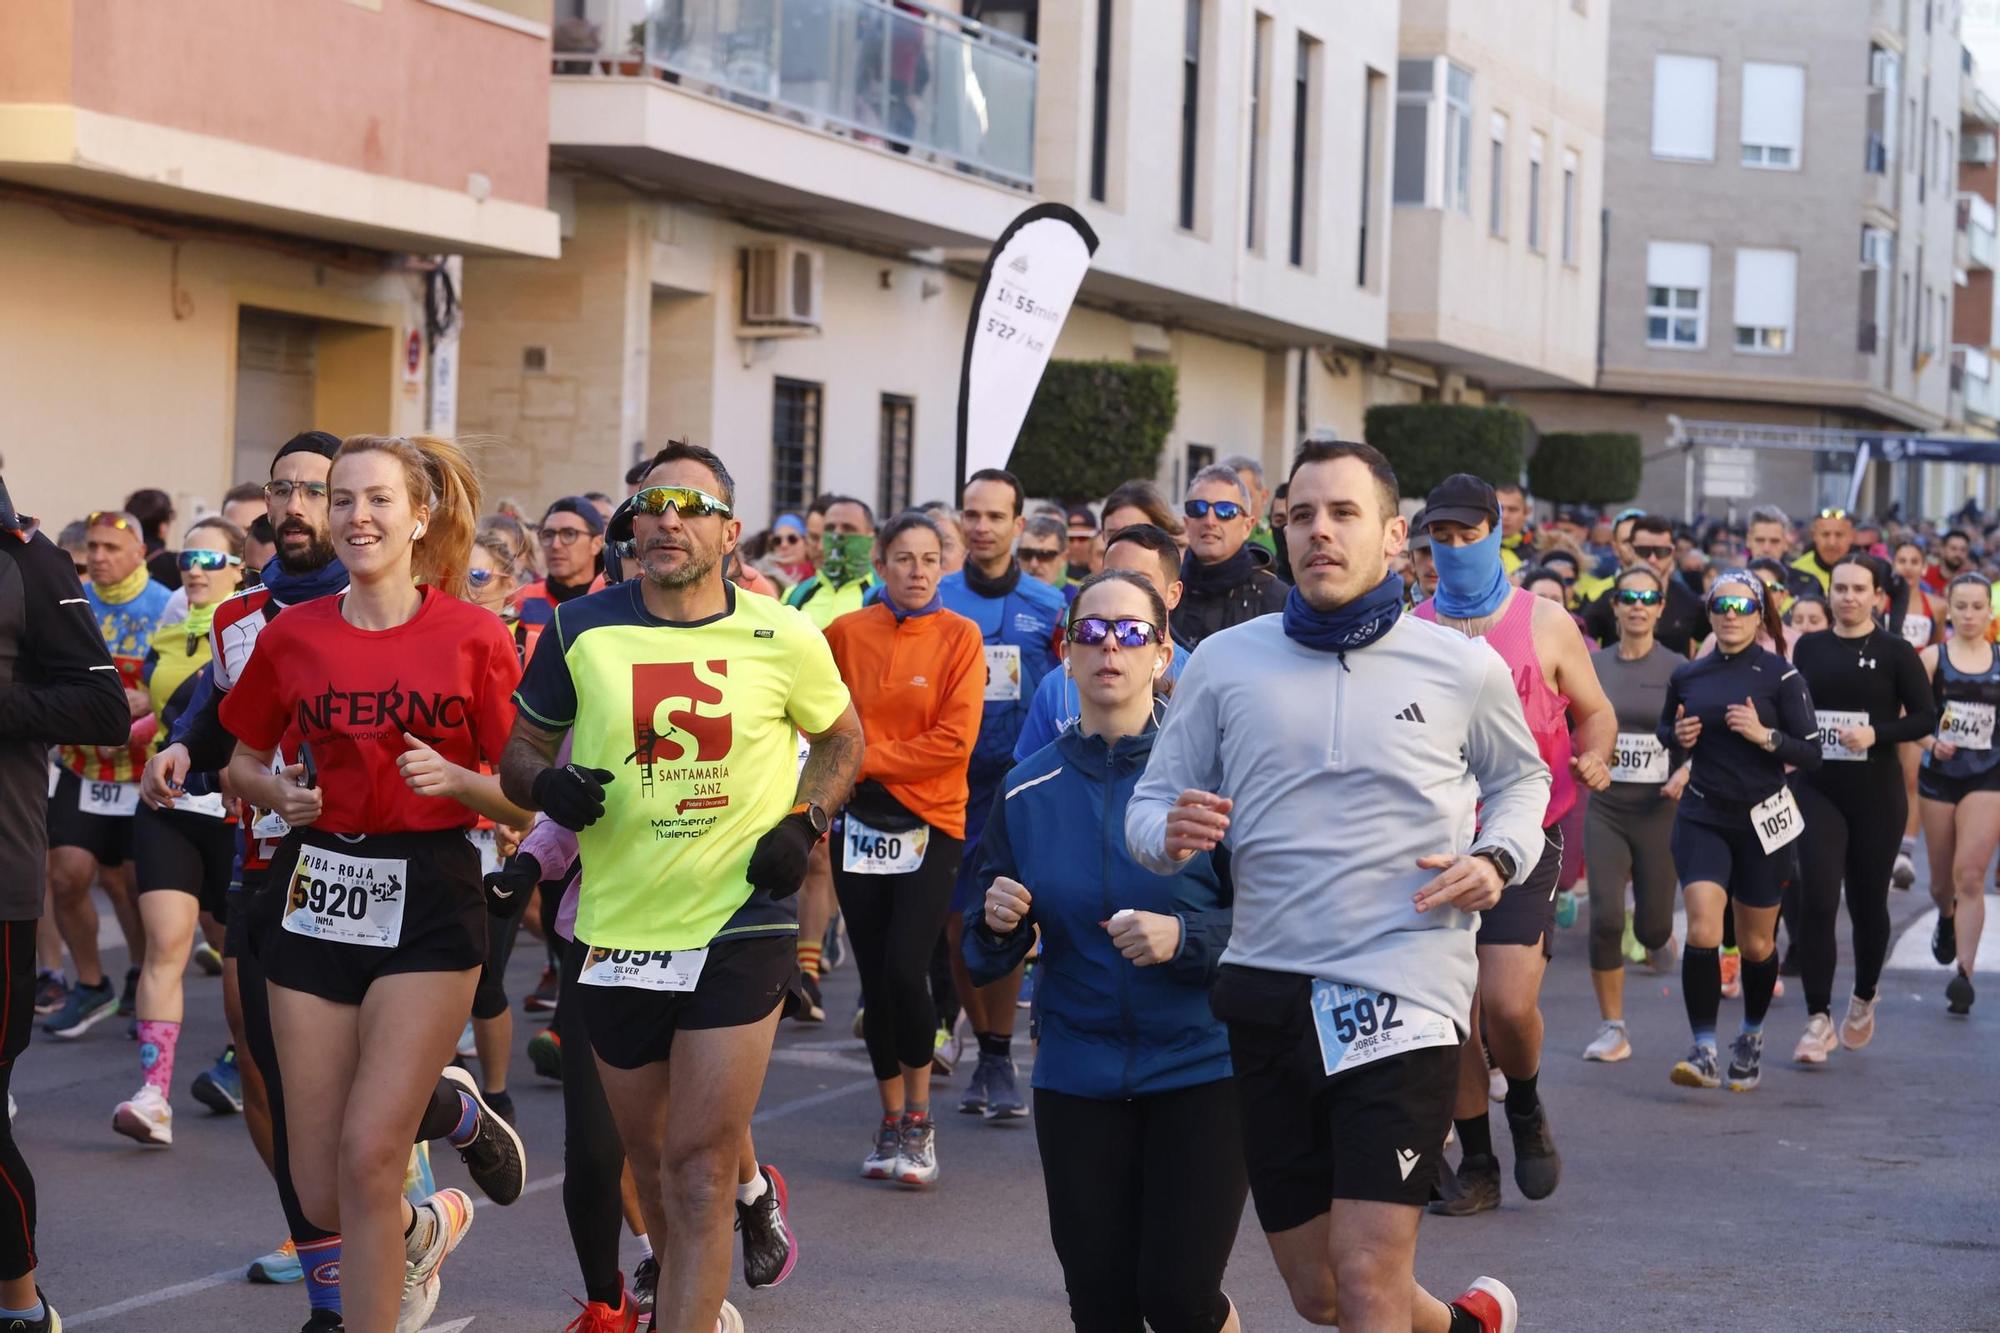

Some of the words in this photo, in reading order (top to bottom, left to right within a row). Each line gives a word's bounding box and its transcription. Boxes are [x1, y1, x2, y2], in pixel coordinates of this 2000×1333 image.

[997, 288, 1013, 305] 1h
[659, 764, 730, 782] SANTAMARÍA
[91, 783, 122, 802] 507
[694, 783, 722, 796] SANZ
[651, 816, 718, 828] Montserrat
[1760, 806, 1793, 839] 1057
[850, 834, 902, 860] 1460
[292, 873, 368, 921] 5920
[315, 915, 334, 927] INMA
[613, 965, 640, 976] SILVER
[1331, 991, 1404, 1044] 592
[1353, 1034, 1379, 1052] JORGE
[1381, 1030, 1393, 1042] SE
